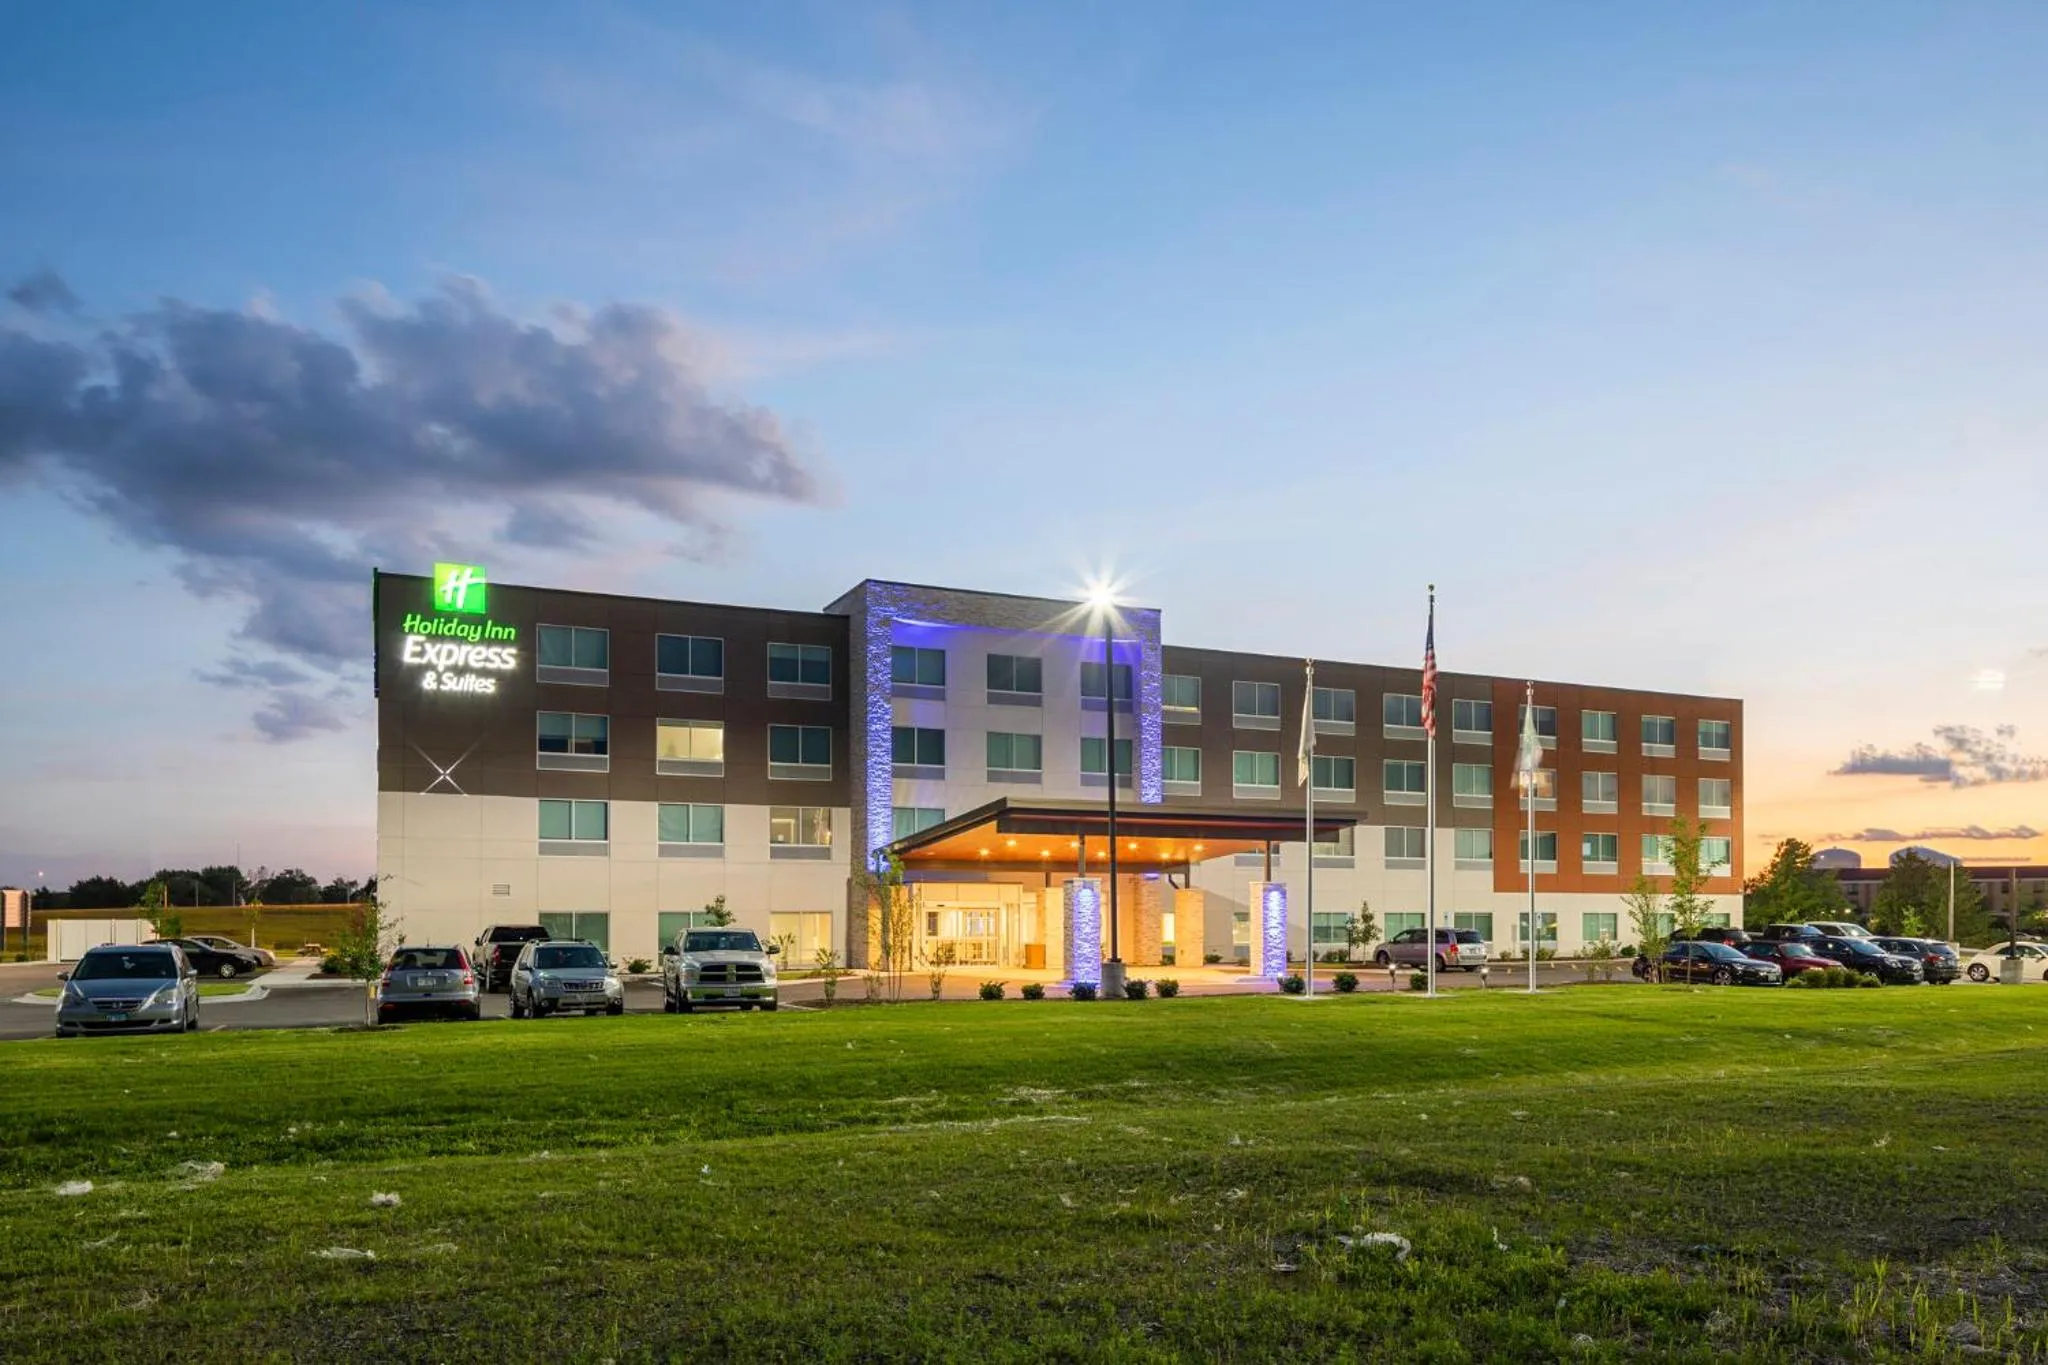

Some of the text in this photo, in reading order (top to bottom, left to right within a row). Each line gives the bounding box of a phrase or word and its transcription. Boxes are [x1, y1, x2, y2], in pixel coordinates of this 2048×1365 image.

[403, 613, 516, 642] Holiday Inn
[403, 635, 517, 672] Express
[422, 670, 496, 693] & Suites
